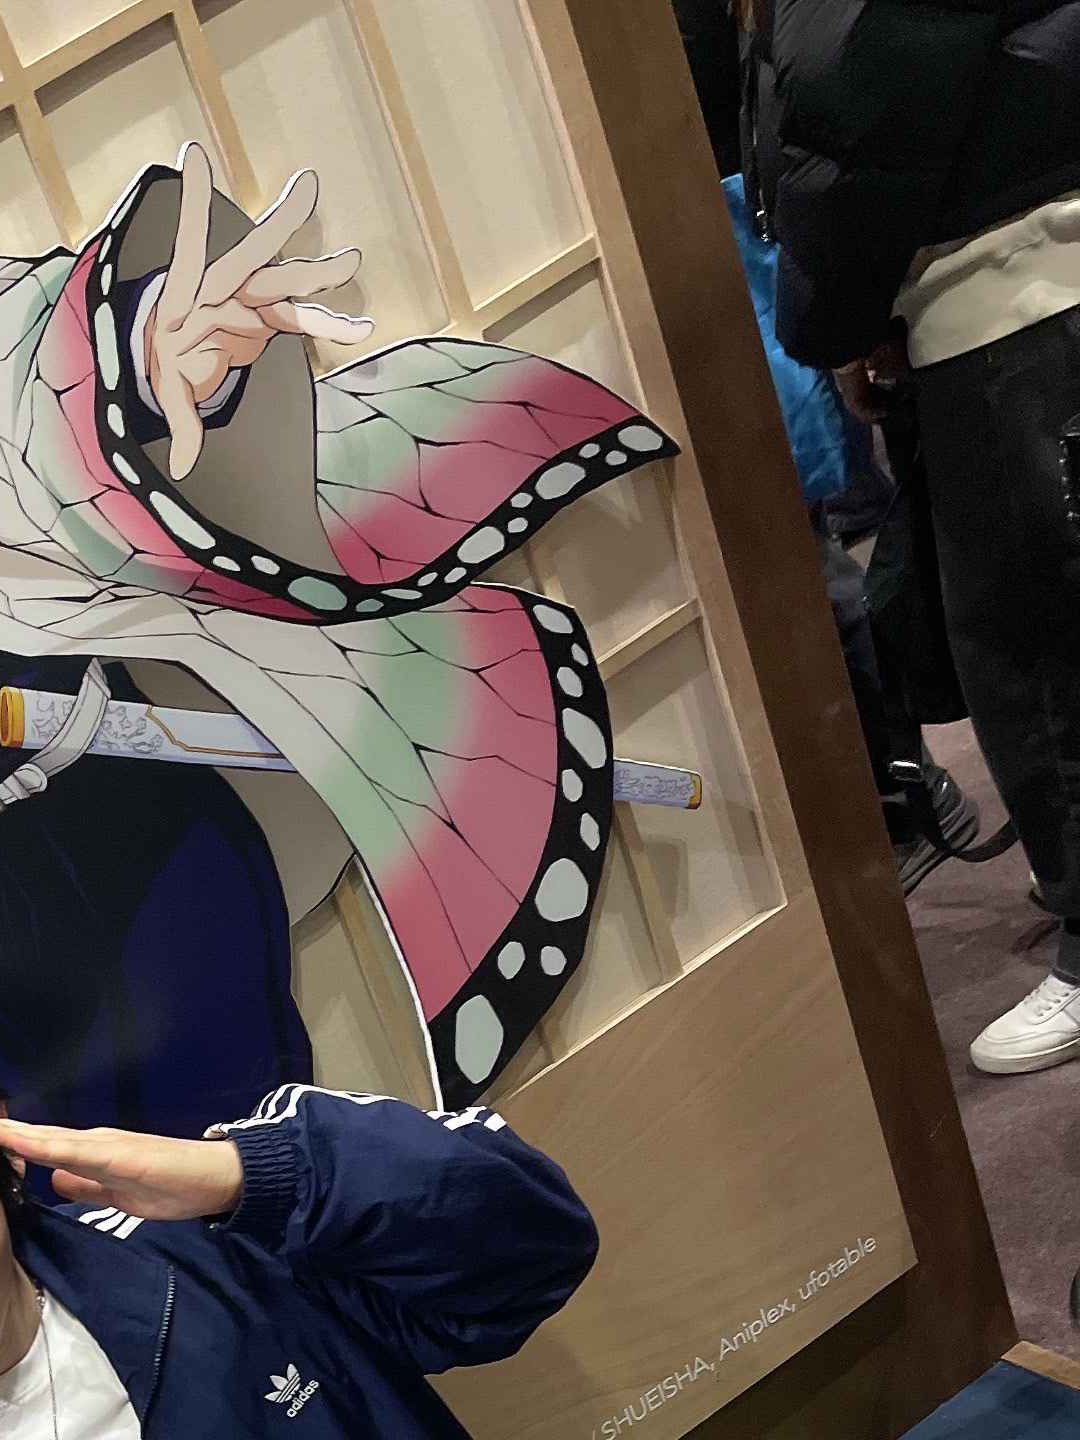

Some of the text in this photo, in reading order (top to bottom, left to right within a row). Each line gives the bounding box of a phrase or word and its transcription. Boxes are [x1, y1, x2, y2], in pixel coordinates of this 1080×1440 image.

[720, 1298, 797, 1361] Aniplex,
[798, 1236, 877, 1300] ufotable
[286, 1379, 320, 1418] adidas
